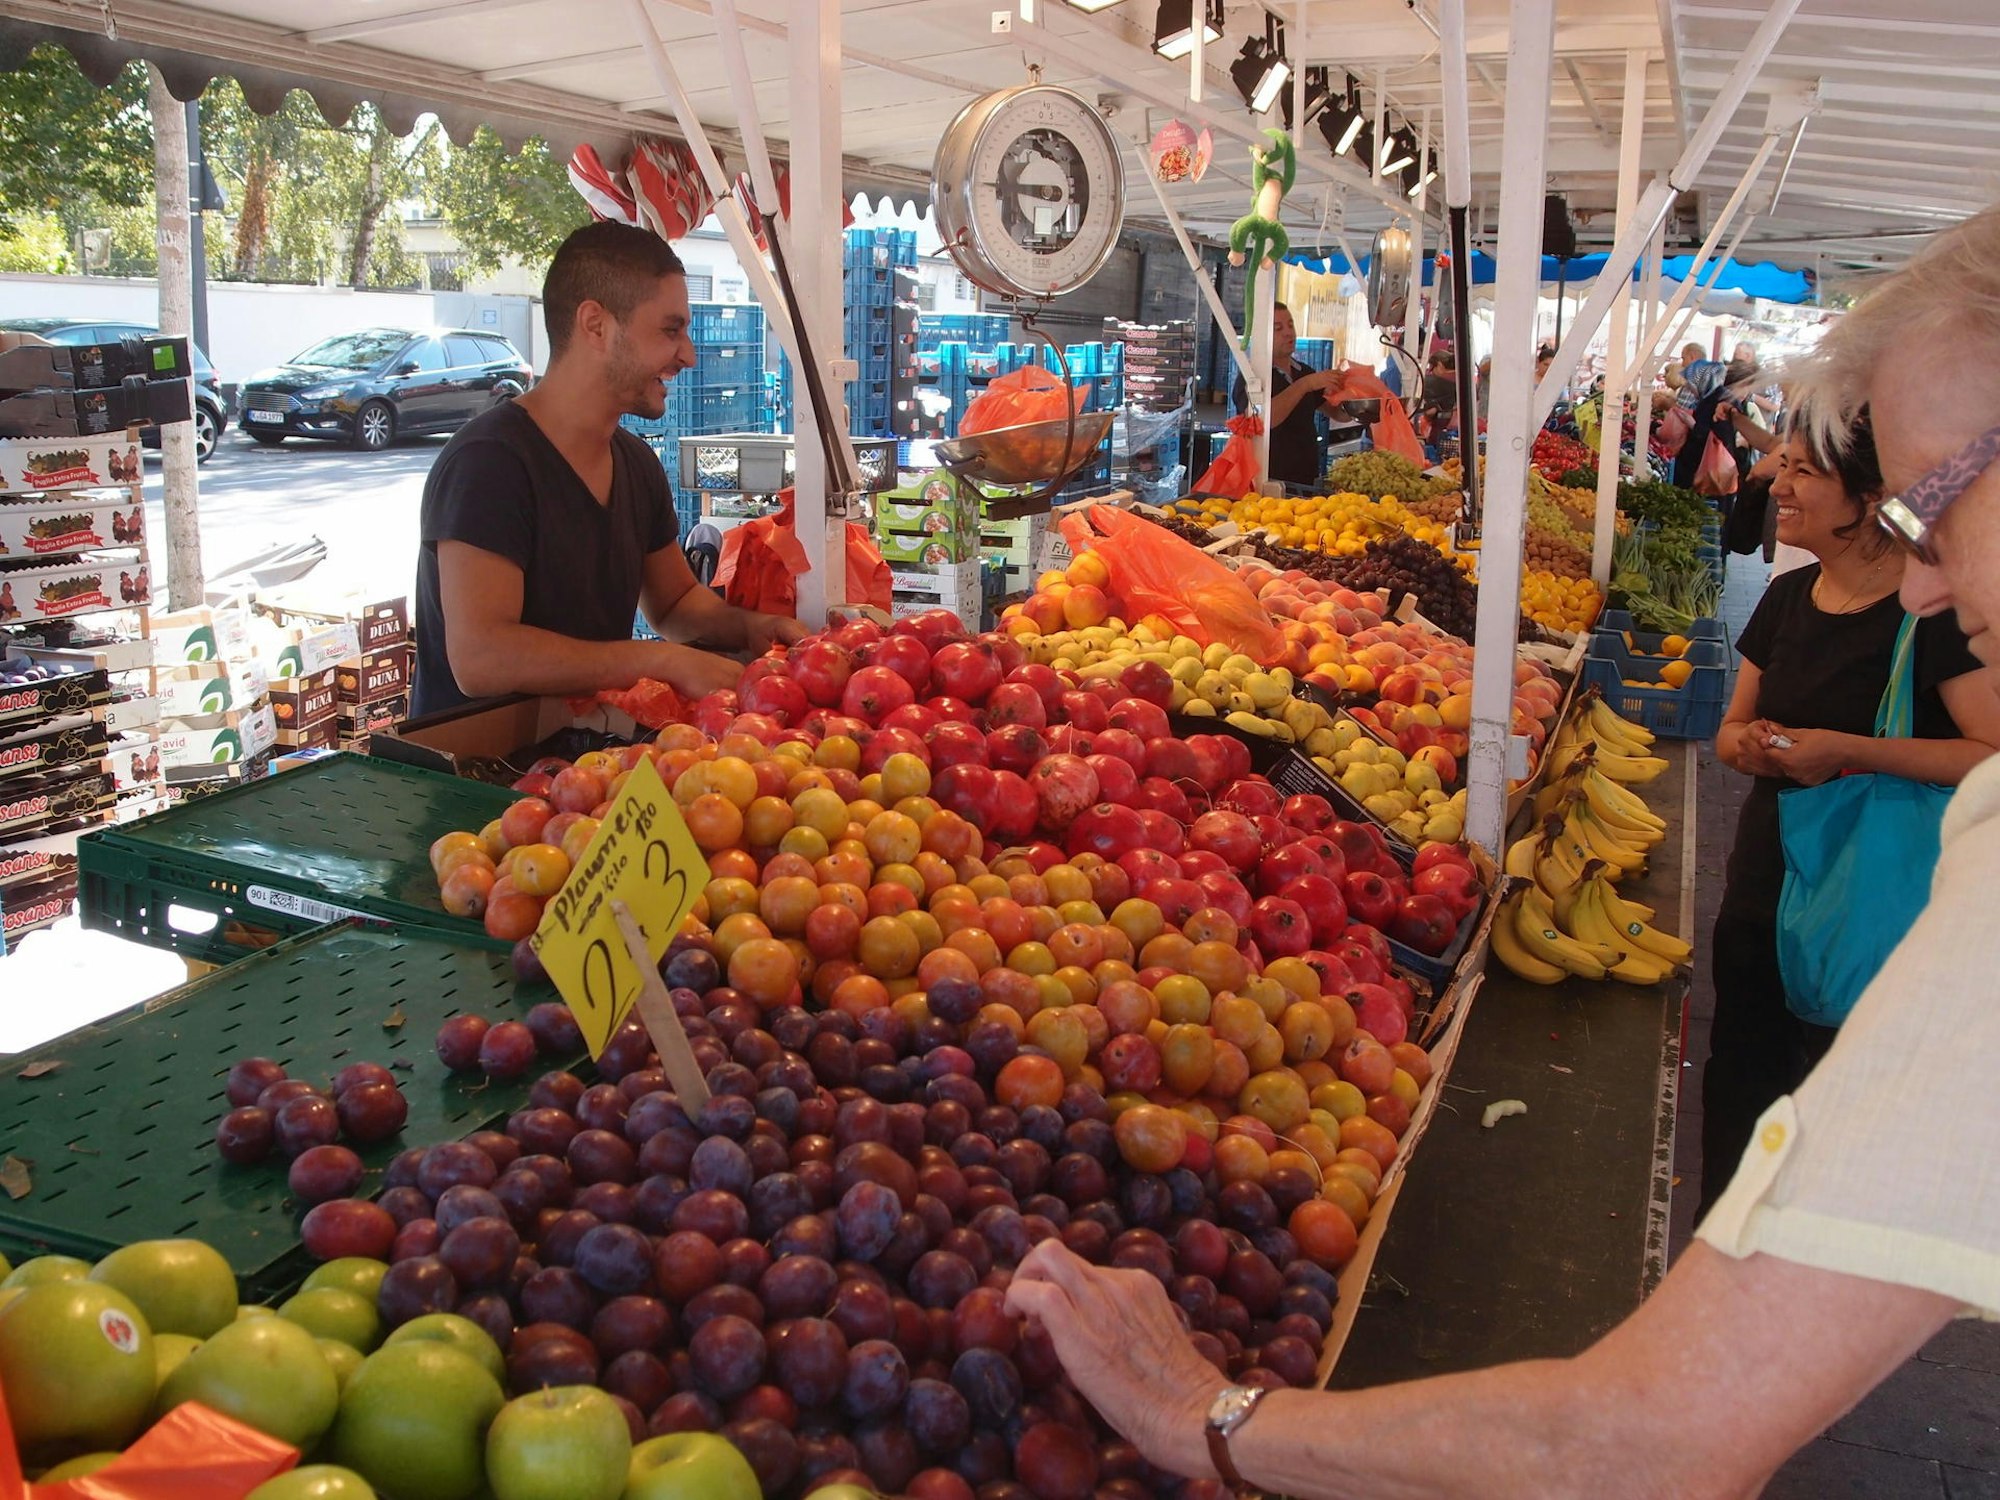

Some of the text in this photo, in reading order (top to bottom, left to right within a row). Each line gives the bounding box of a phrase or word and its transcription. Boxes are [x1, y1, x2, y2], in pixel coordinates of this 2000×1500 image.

[35, 470, 88, 486] Puglia Extra Frutta
[36, 534, 92, 550] Puglia Extra Frutta
[47, 595, 100, 613] Puglia Extra Frutta
[369, 620, 400, 639] DUNA
[368, 668, 400, 689] DUNA
[305, 691, 333, 713] DUNA
[644, 839, 687, 932] 3
